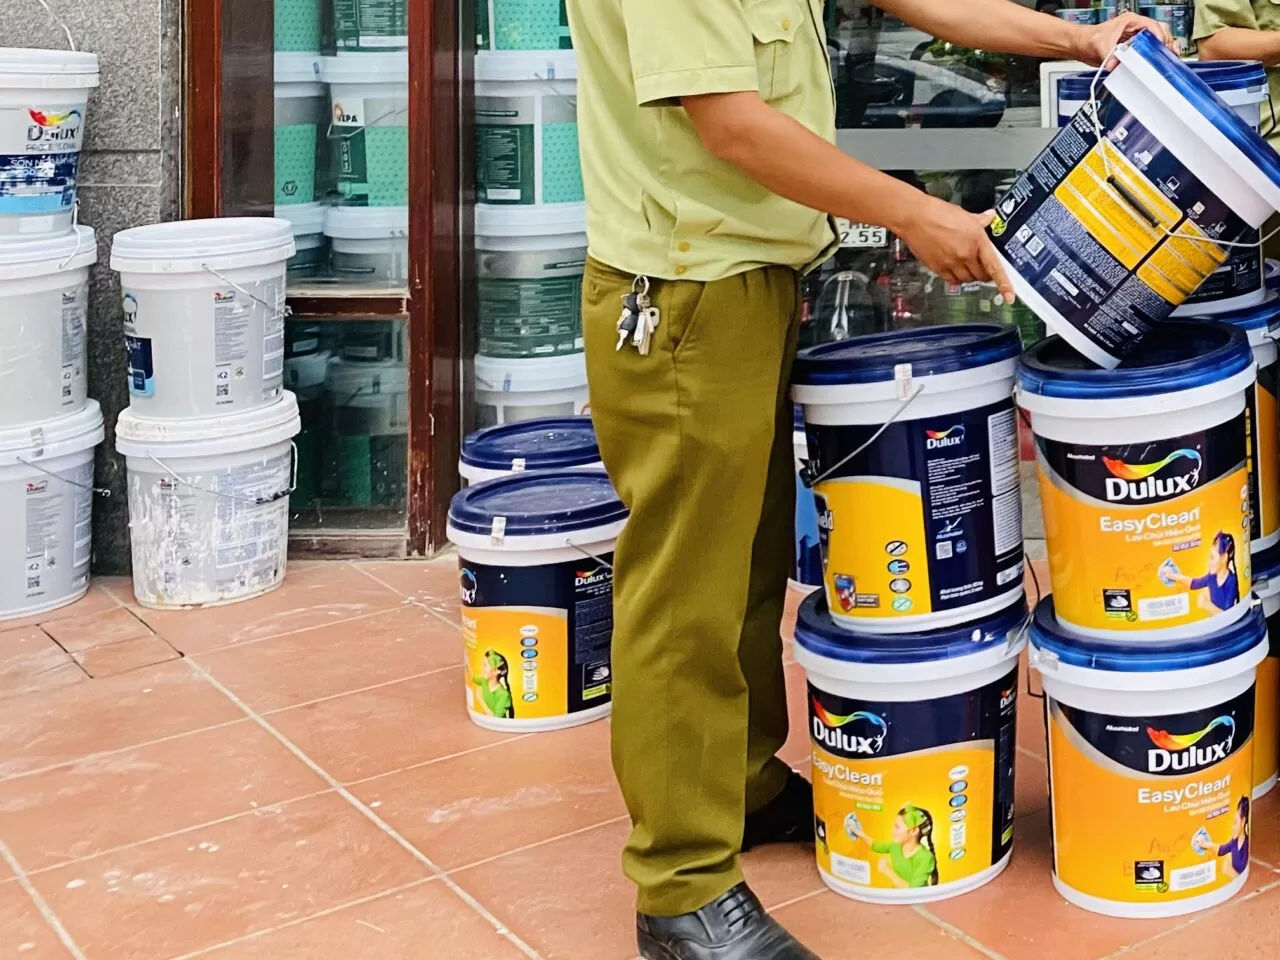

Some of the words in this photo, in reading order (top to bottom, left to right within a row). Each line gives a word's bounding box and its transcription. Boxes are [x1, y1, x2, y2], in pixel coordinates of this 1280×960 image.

[840, 230, 882, 243] 2.55
[926, 436, 961, 450] Dulux
[1105, 475, 1192, 501] Dulux
[1100, 507, 1201, 534] EasyClean
[575, 574, 604, 586] Dulux
[813, 716, 874, 755] Dulux
[812, 751, 883, 786] EasyClean
[1147, 742, 1226, 772] Dulux
[1137, 774, 1231, 805] EasyClean
